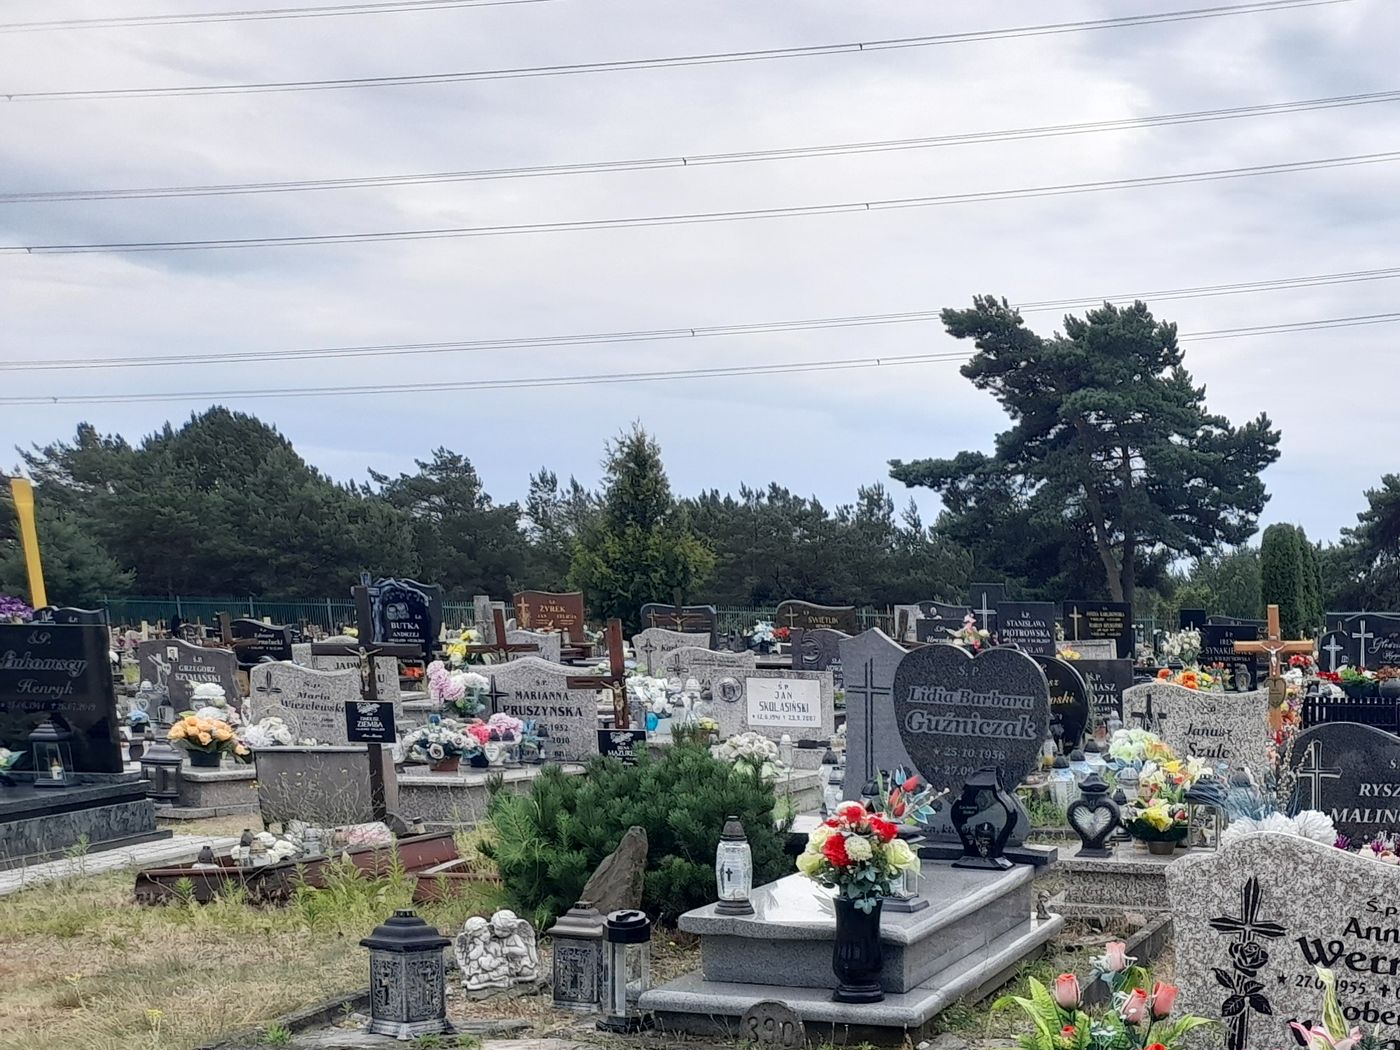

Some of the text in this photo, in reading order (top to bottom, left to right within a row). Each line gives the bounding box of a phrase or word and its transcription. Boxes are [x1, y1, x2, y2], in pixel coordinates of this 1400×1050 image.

[1002, 629, 1051, 637] PIOTROWSKA
[178, 665, 217, 673] GRZEGORZ
[174, 674, 222, 683] SZYMAŃSKI
[16, 679, 74, 700] Henryk
[297, 691, 331, 700] Maria
[515, 691, 570, 701] MARIANNA
[774, 691, 793, 700] JAN
[907, 685, 1035, 710] Lidia Barbara
[758, 700, 810, 713] SKOLASIŃSKI
[905, 709, 1037, 740] Guźniczak
[1185, 722, 1233, 737] Janusz
[1189, 742, 1231, 759] Szulc
